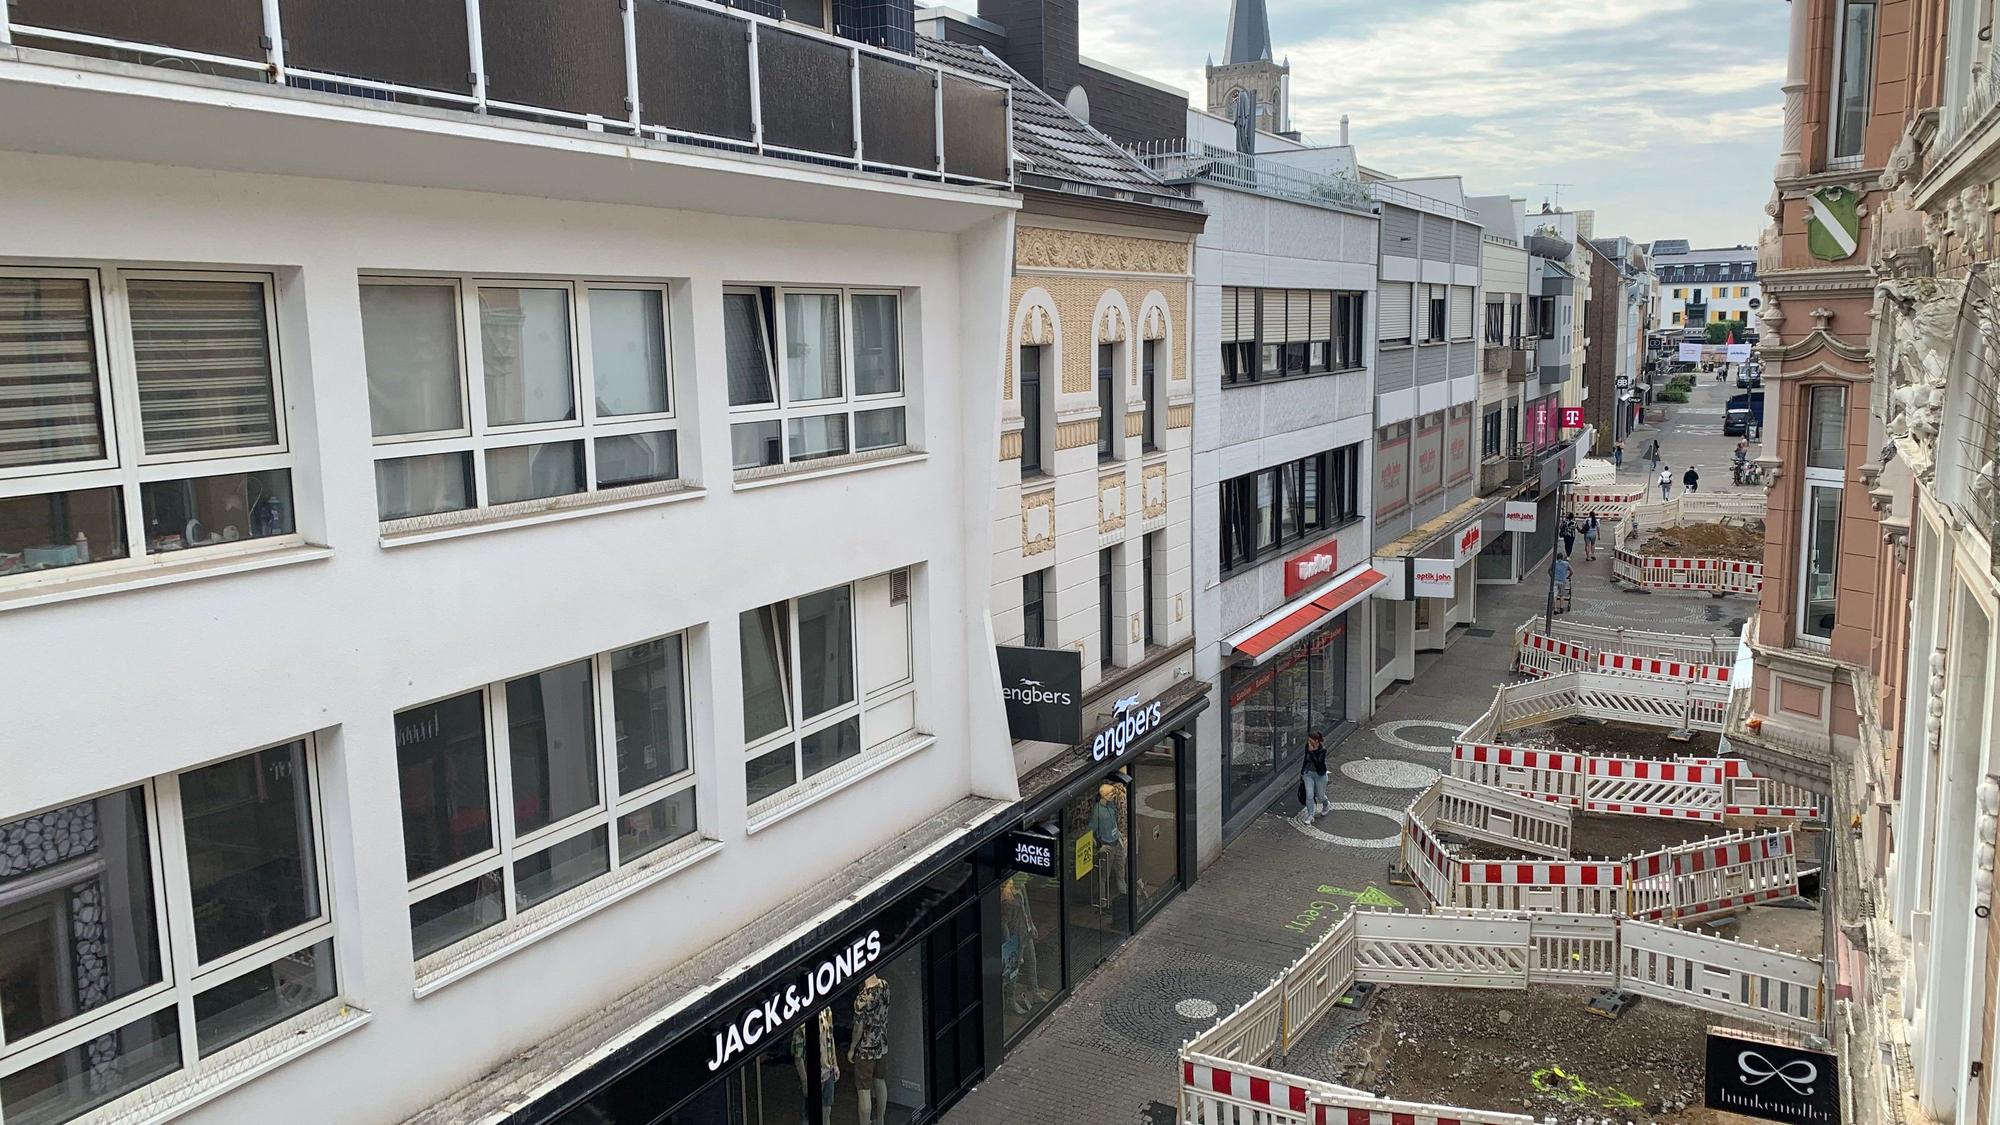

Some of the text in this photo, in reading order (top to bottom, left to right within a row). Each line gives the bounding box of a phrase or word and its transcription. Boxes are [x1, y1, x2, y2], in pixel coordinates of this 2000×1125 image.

[1566, 410, 1579, 425] T
[1416, 572, 1452, 583] optik john
[1002, 686, 1071, 705] engbers
[1092, 701, 1161, 761] engbers
[1015, 843, 1050, 857] JACK&
[1015, 853, 1050, 867] JONES
